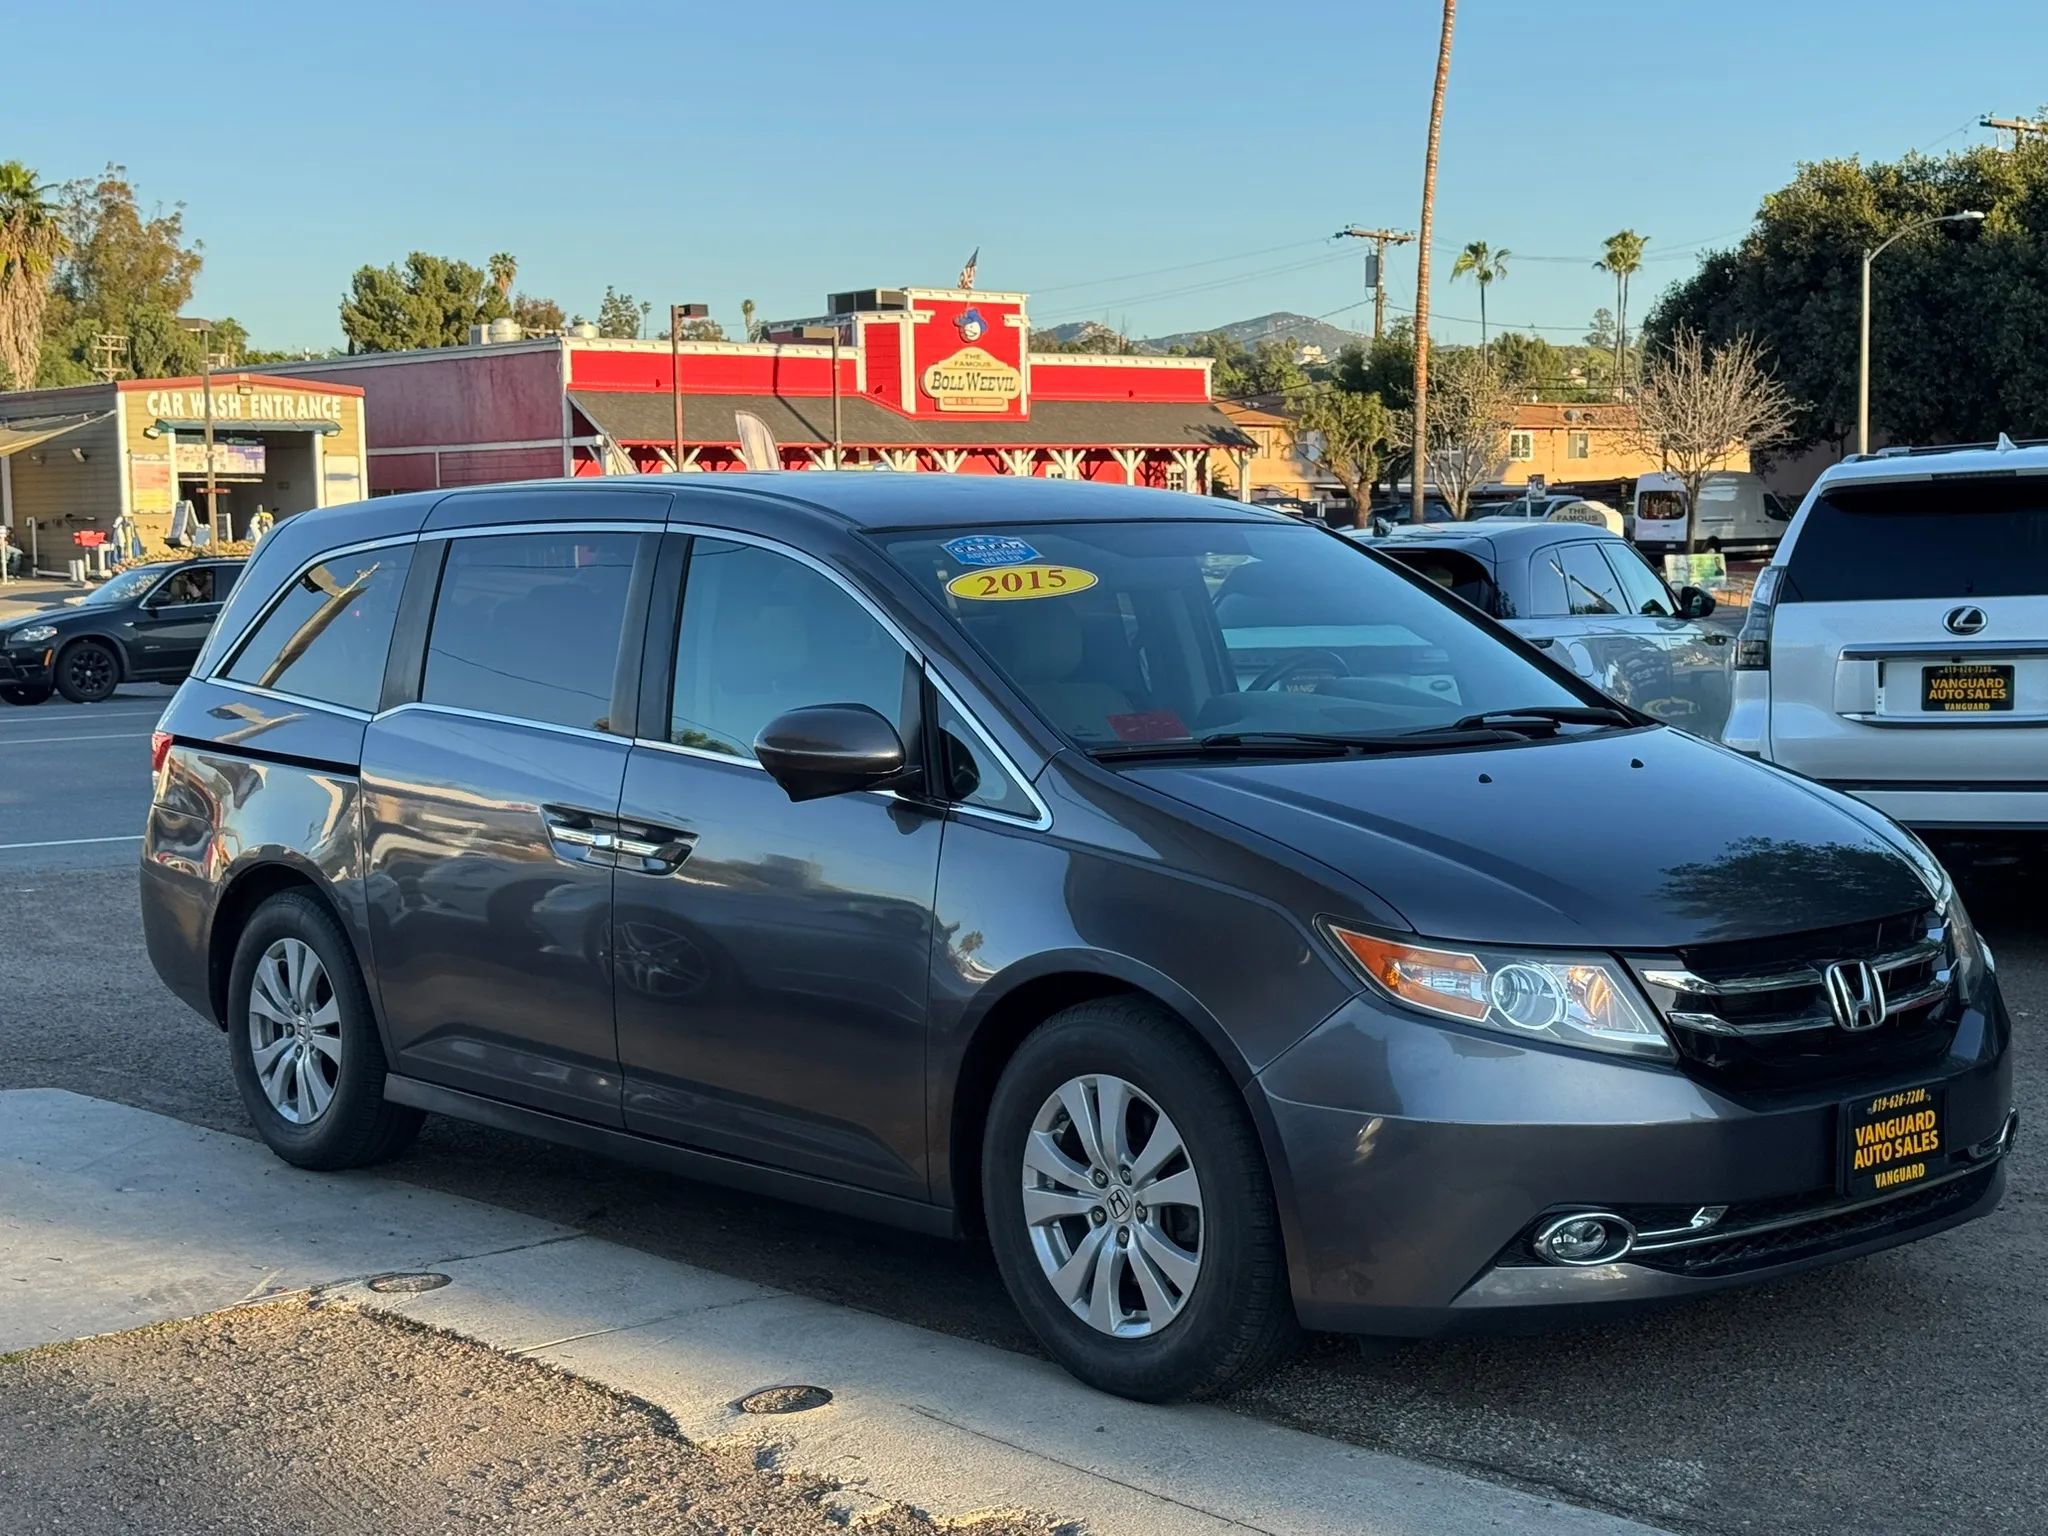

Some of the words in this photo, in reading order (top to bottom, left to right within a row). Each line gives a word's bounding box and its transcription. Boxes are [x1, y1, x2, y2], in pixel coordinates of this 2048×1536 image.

[147, 391, 185, 417] CAR
[251, 394, 341, 419] ENTRANCE
[1556, 514, 1599, 522] FAMOUS
[977, 569, 1067, 596] 2015
[1929, 689, 1965, 699] AUTO
[1966, 688, 2007, 699] SALES
[1931, 678, 2004, 689] VANGUARD
[1944, 703, 1990, 711] VANGUARD
[1872, 1088, 1925, 1113] 619-626-7288
[1855, 1110, 1936, 1147] VANGUARD
[1854, 1142, 1893, 1170] AUTO
[1895, 1130, 1939, 1159] SALES
[1875, 1163, 1925, 1189] VANGUARD
